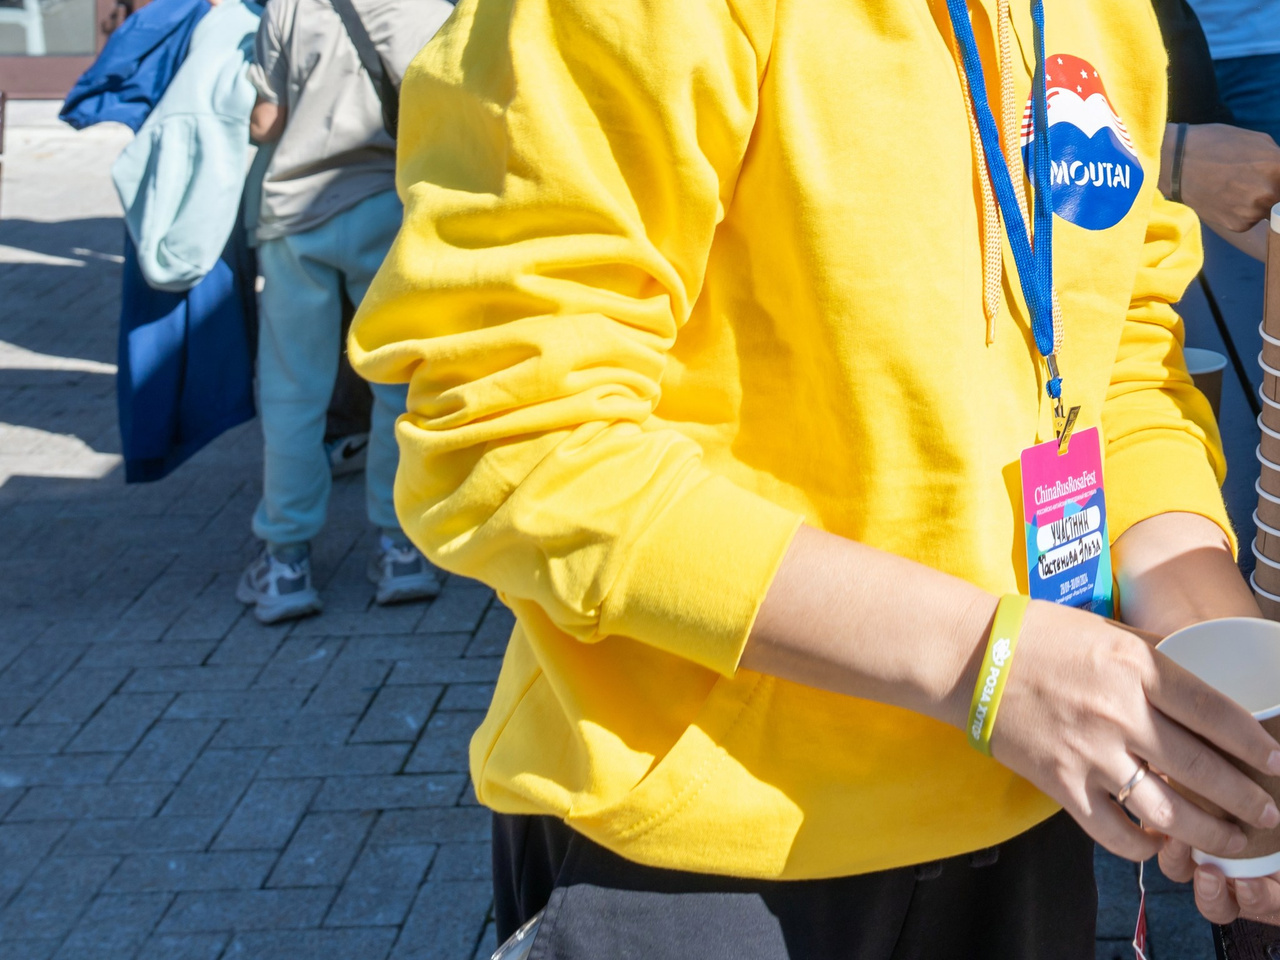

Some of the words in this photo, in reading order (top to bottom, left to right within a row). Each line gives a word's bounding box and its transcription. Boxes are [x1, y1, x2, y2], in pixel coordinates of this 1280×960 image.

[1050, 160, 1130, 189] MOUTAI
[1034, 470, 1097, 506] ChinaRusRosaFest
[980, 666, 1000, 702] РОЗА
[972, 703, 987, 741] ХУТОР
